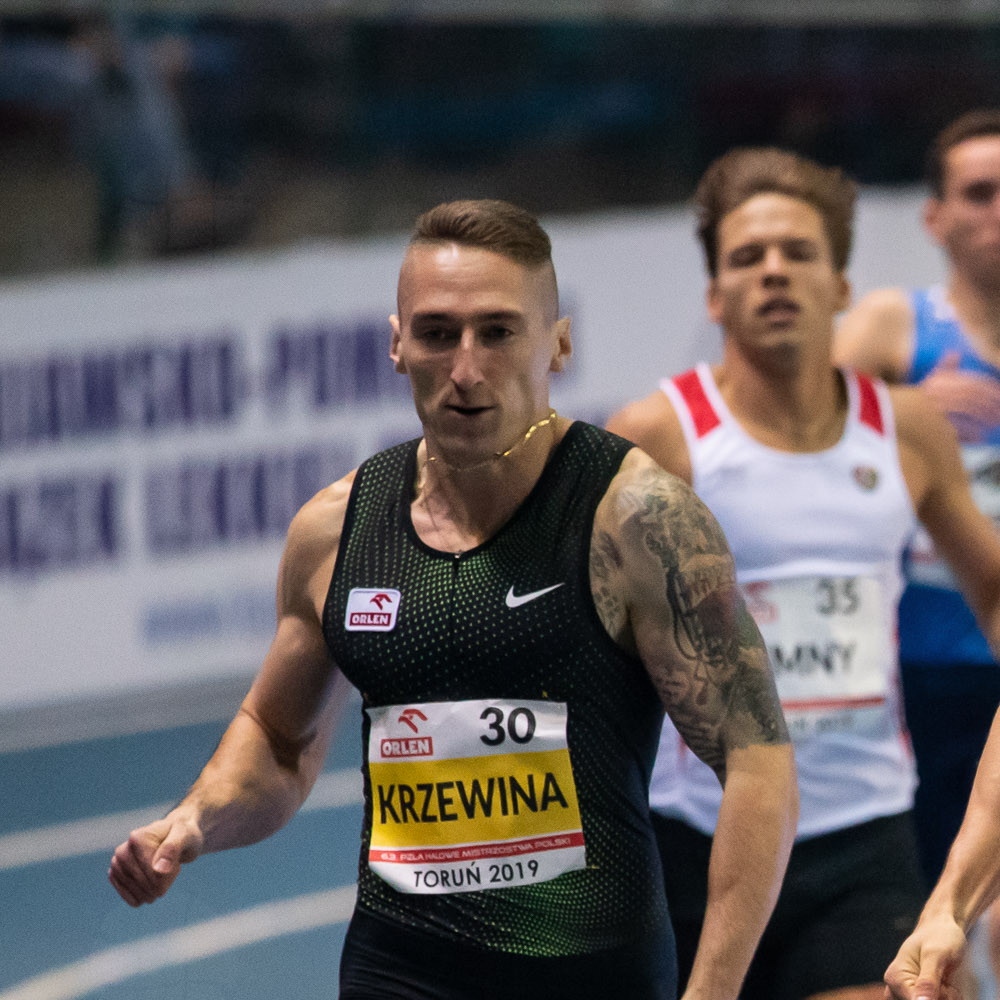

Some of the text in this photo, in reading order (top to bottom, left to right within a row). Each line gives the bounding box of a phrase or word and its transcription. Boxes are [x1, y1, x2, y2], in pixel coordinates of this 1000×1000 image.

[352, 614, 388, 625] ORLEN
[479, 706, 536, 746] 30
[382, 739, 431, 756] ORLEN
[377, 772, 569, 825] KRZEWINA
[535, 837, 571, 849] POLSKI
[414, 860, 538, 888] TORUŃ 2019
